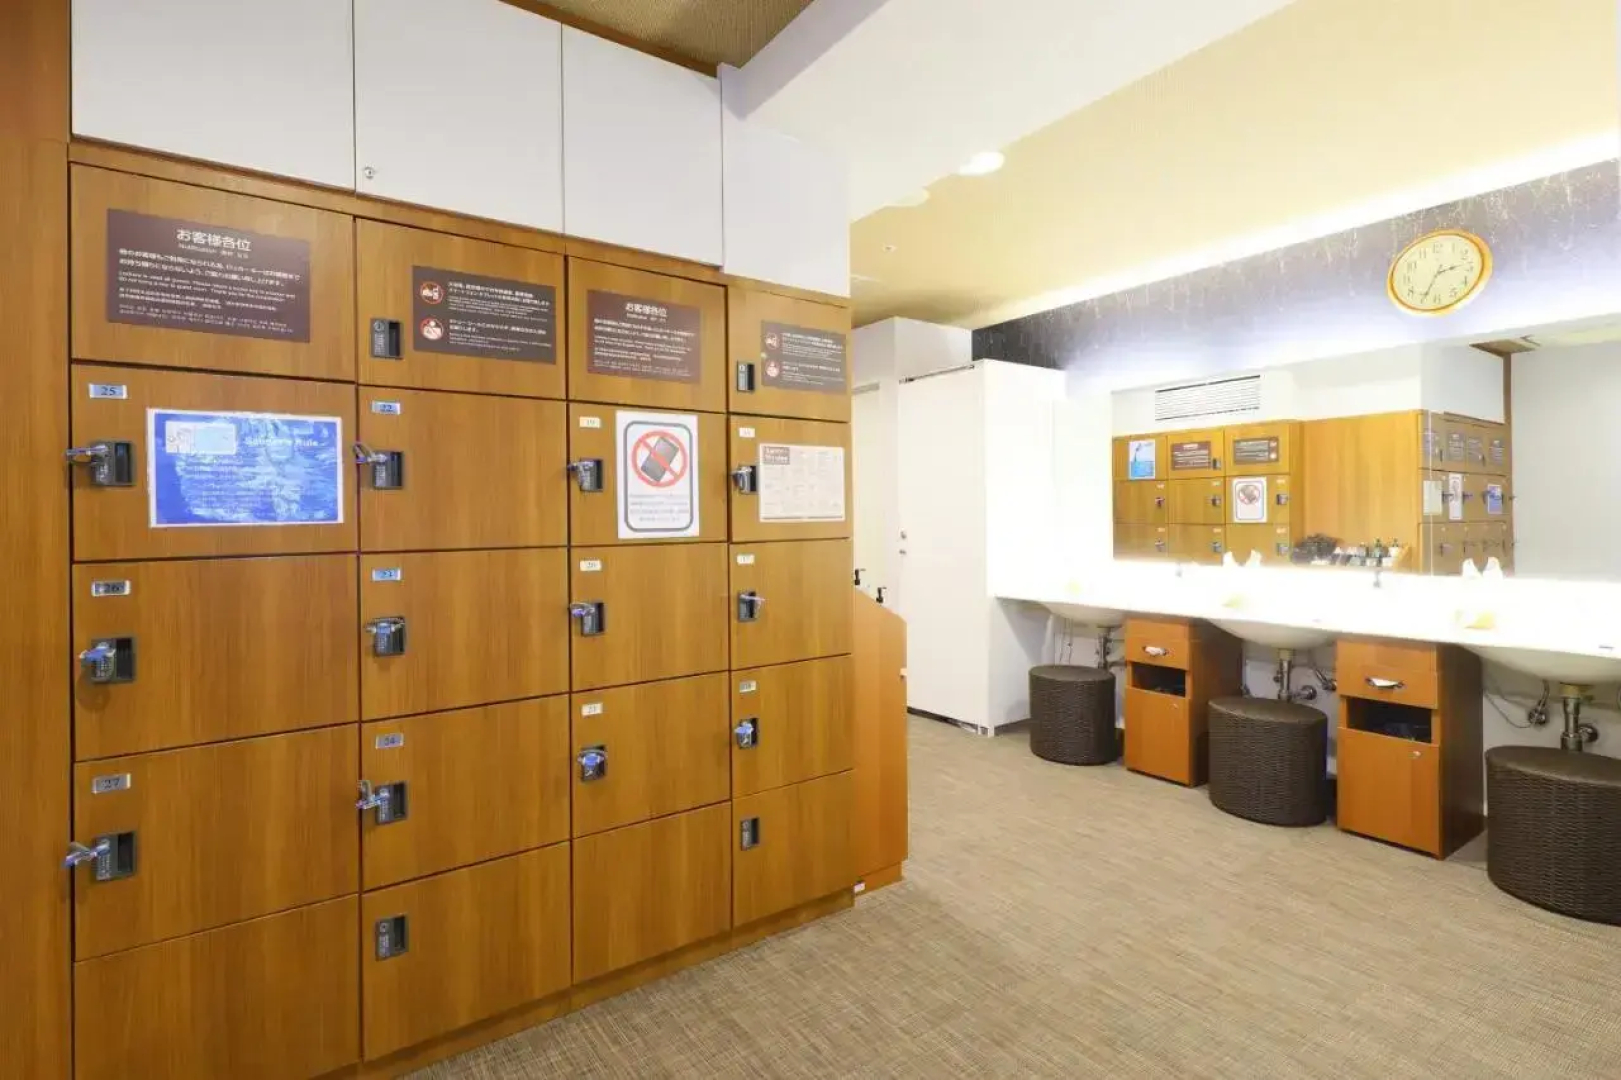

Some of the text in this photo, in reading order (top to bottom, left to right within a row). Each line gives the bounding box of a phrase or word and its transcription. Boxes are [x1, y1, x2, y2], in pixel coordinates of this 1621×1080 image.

[177, 229, 251, 251] お客様各位
[101, 386, 116, 396] 25
[104, 777, 120, 788] 27
